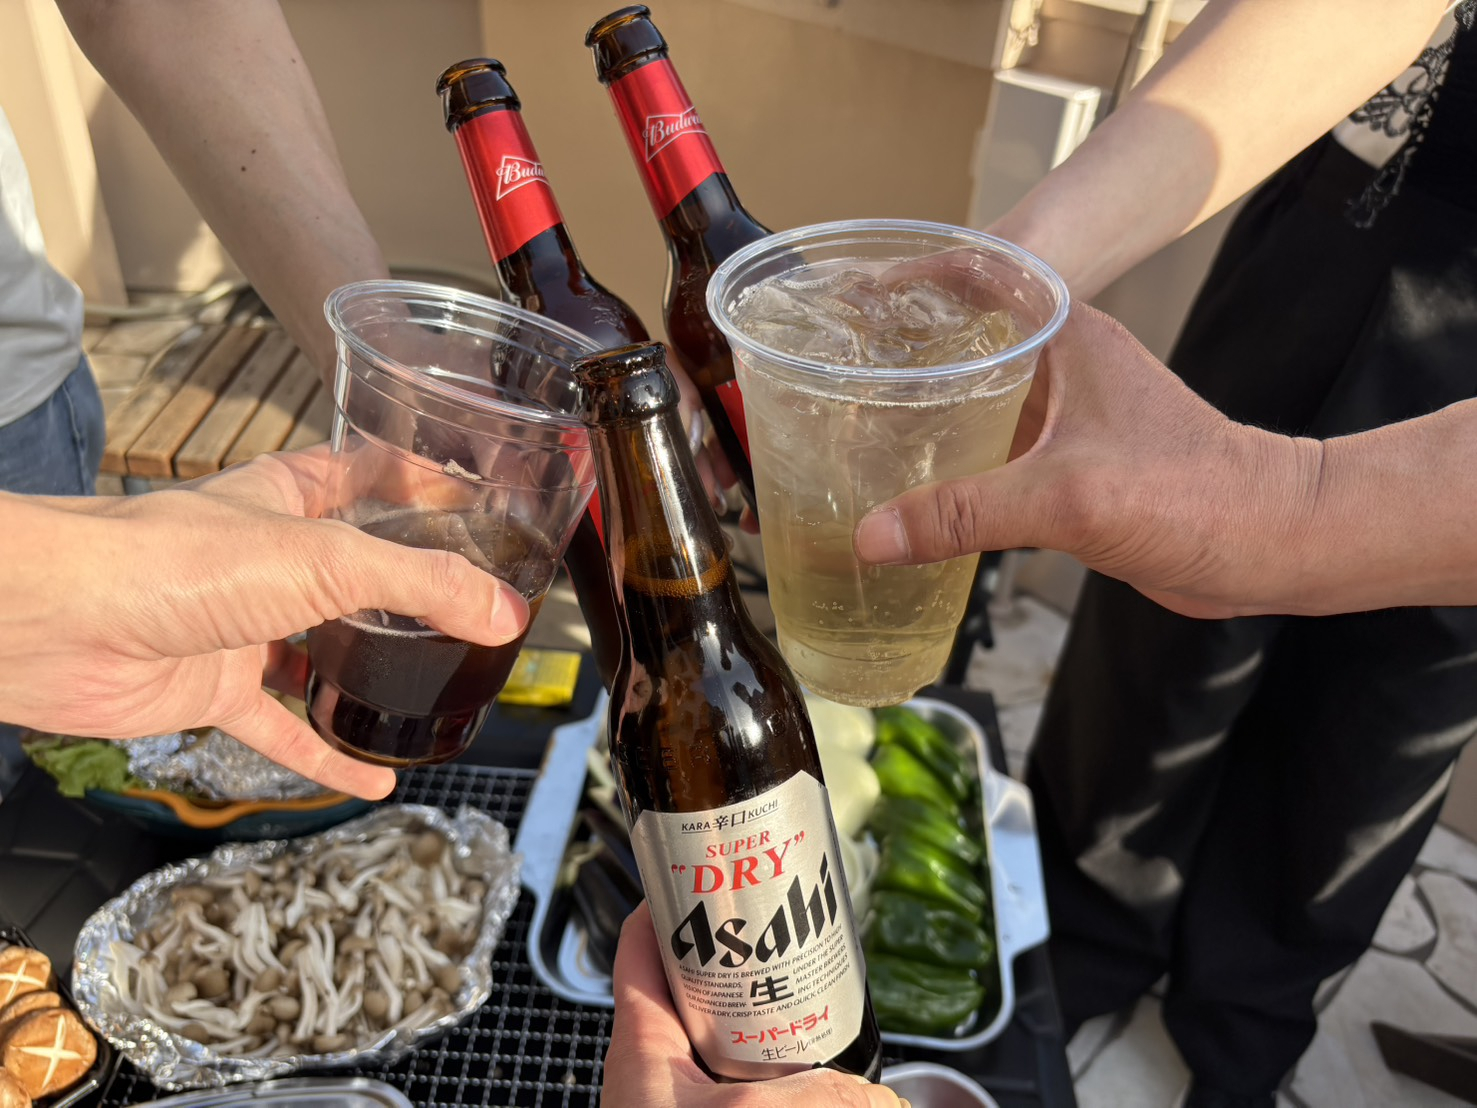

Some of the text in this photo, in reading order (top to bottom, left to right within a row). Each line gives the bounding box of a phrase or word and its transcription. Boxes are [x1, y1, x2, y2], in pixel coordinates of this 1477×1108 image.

[681, 820, 711, 831] KARA
[712, 809, 746, 831] 辛口
[747, 798, 779, 819] KUCHI
[705, 830, 771, 859] SUPER
[671, 851, 837, 968] Asahi
[681, 973, 704, 986] QUALITY
[792, 957, 816, 975] UNDER
[817, 951, 828, 962] THE
[683, 983, 702, 995] VISION
[703, 989, 711, 997] OF
[795, 964, 823, 985] MASTER
[823, 942, 847, 969] BREWERS
[696, 968, 716, 978] SUPER
[741, 966, 771, 978] BREWED
[772, 959, 791, 972] WITH
[792, 942, 823, 965] PRECISION
[685, 992, 696, 1001] OUR
[696, 995, 728, 1008] ADVANCED
[797, 983, 811, 994] ING
[812, 953, 848, 986] TECHNIQUES
[688, 1002, 712, 1015] DELIVER
[732, 1010, 752, 1018] CRISP
[753, 1007, 775, 1017] TASTE
[775, 1002, 793, 1012] AND
[816, 977, 836, 994] CLEAN
[750, 975, 794, 1006] 生
[730, 1005, 829, 1044] スーパードライ
